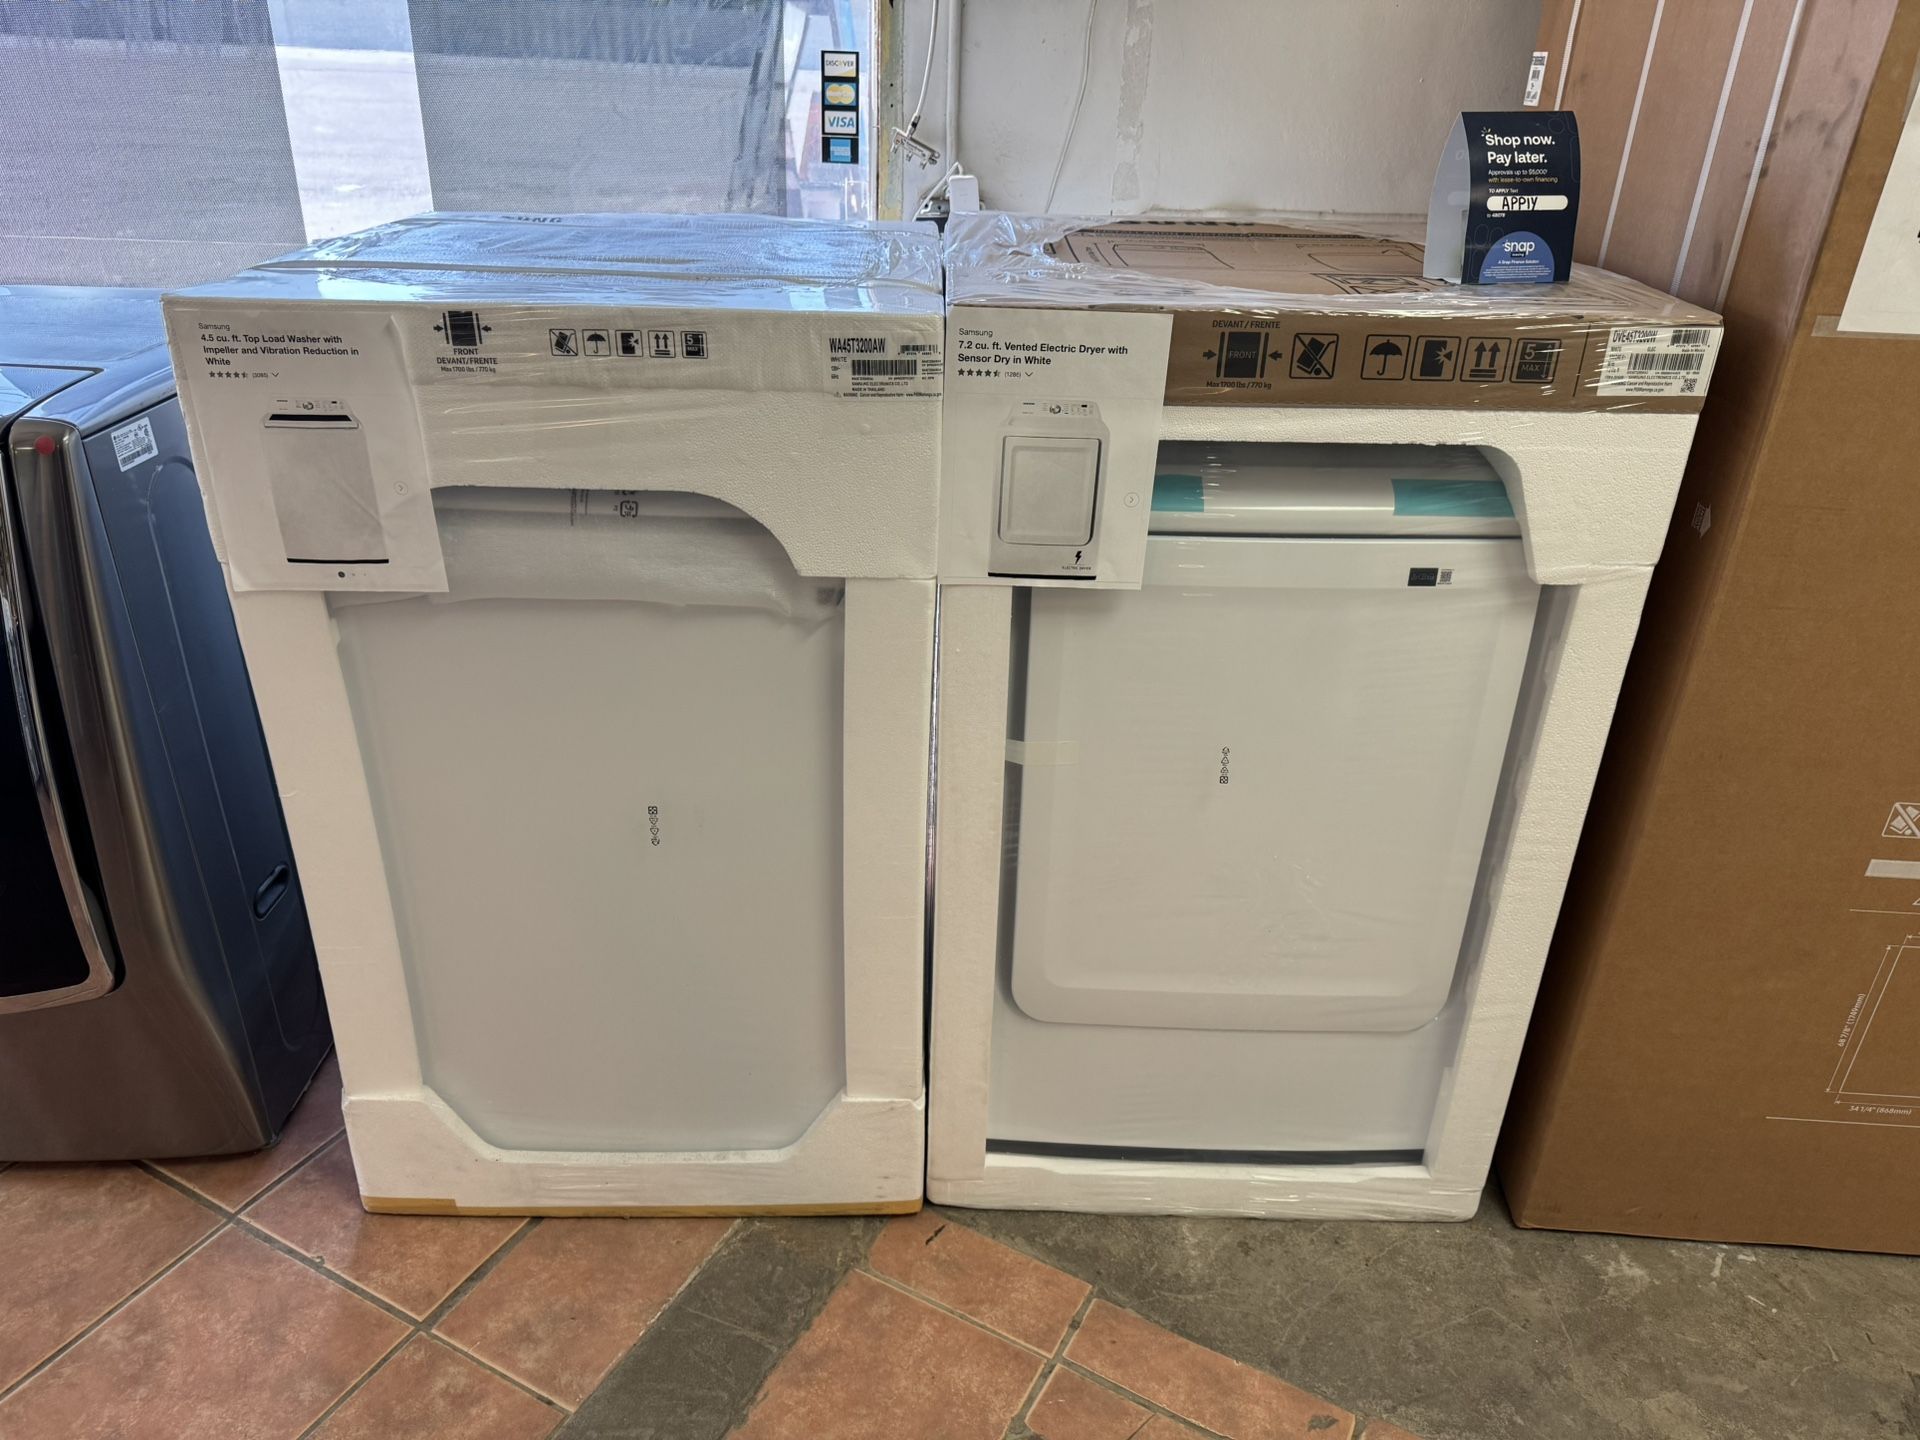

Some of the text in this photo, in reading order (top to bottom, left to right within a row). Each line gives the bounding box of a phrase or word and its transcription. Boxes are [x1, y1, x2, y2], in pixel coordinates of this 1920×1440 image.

[828, 116, 855, 128] VISA
[1485, 134, 1556, 148] Shop now.
[1487, 152, 1548, 166] Pay later.
[1504, 241, 1535, 255] snap
[198, 323, 230, 331] Samsung
[959, 328, 993, 337] Samsung
[243, 335, 260, 344] Top
[323, 336, 342, 344] with
[687, 334, 694, 345] 5
[203, 346, 238, 354] Impeller
[260, 346, 300, 355] Vibration
[303, 347, 348, 356] Reduction
[350, 348, 359, 356] in
[829, 338, 886, 353] WA45T3200AW
[958, 341, 972, 349] 7.2
[992, 342, 1001, 350] ft.
[1004, 342, 1038, 351] Vented
[1040, 344, 1076, 352] Electric
[1079, 344, 1106, 354] Dryer
[1108, 346, 1128, 354] with
[1524, 344, 1537, 360] 5
[205, 357, 230, 366] White
[958, 354, 1051, 365] Sensor Dry in White
[1837, 1039, 1846, 1047] 68
